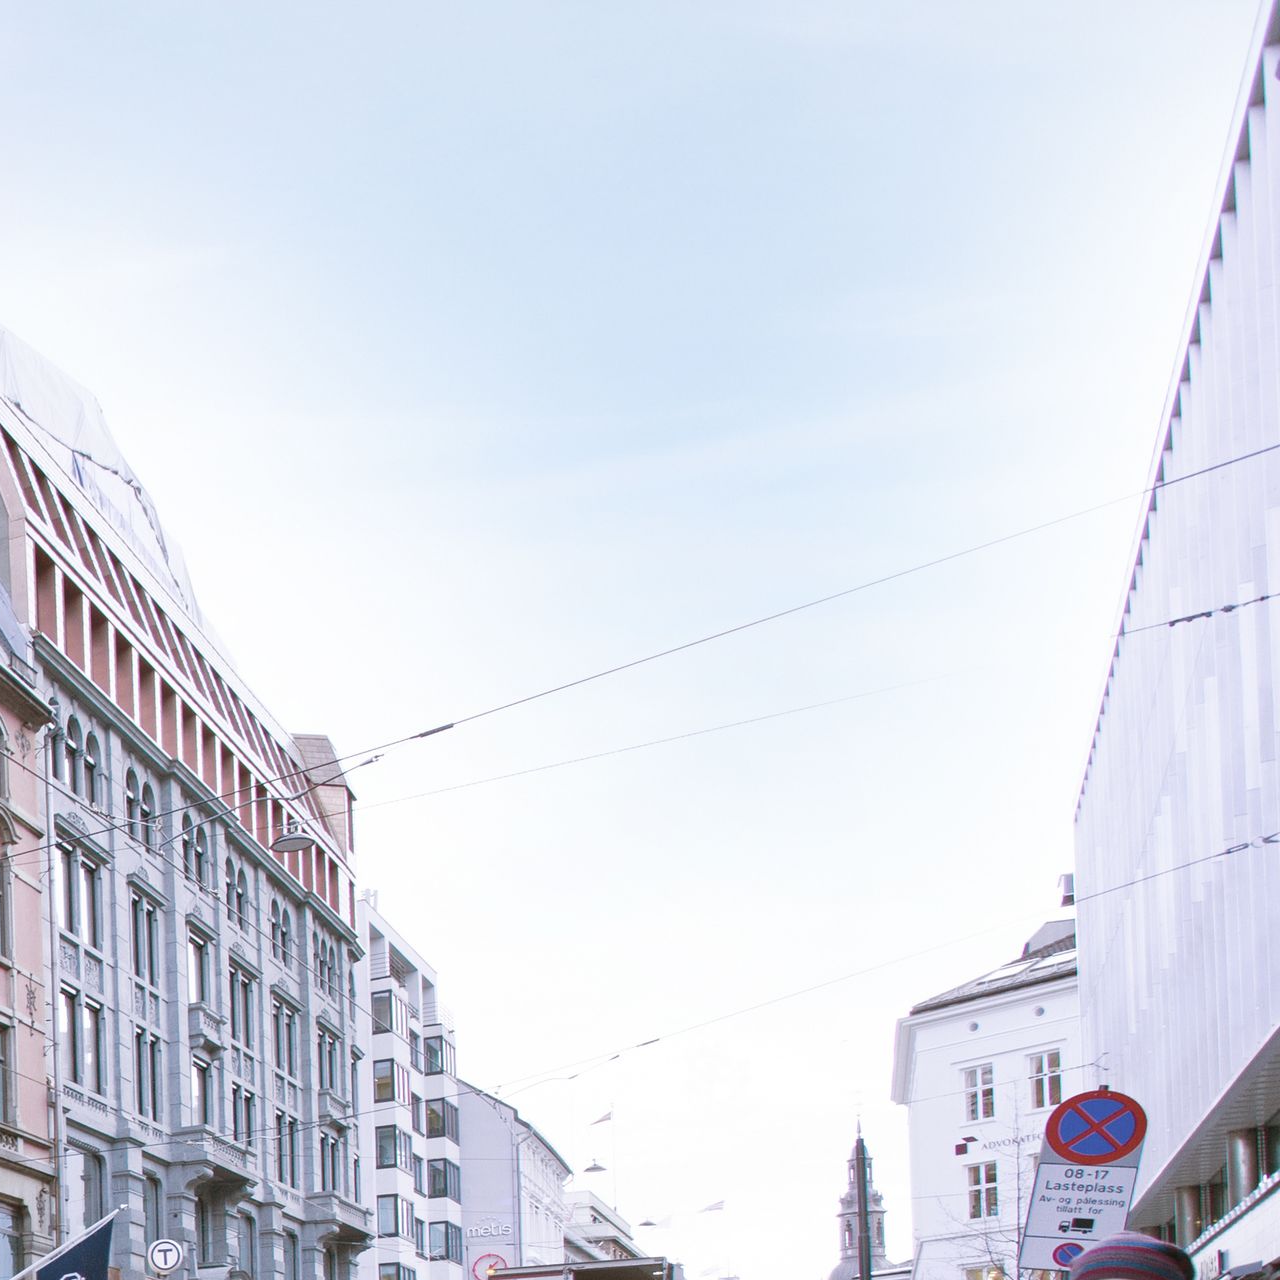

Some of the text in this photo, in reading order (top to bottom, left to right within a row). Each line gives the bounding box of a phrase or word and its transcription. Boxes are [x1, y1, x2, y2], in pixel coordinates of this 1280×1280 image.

[1045, 1181, 1125, 1194] Lasteplass
[1058, 1197, 1071, 1205] og
[1076, 1196, 1126, 1208] pålessing
[1056, 1206, 1104, 1215] tillatt for
[466, 1223, 512, 1238] metis
